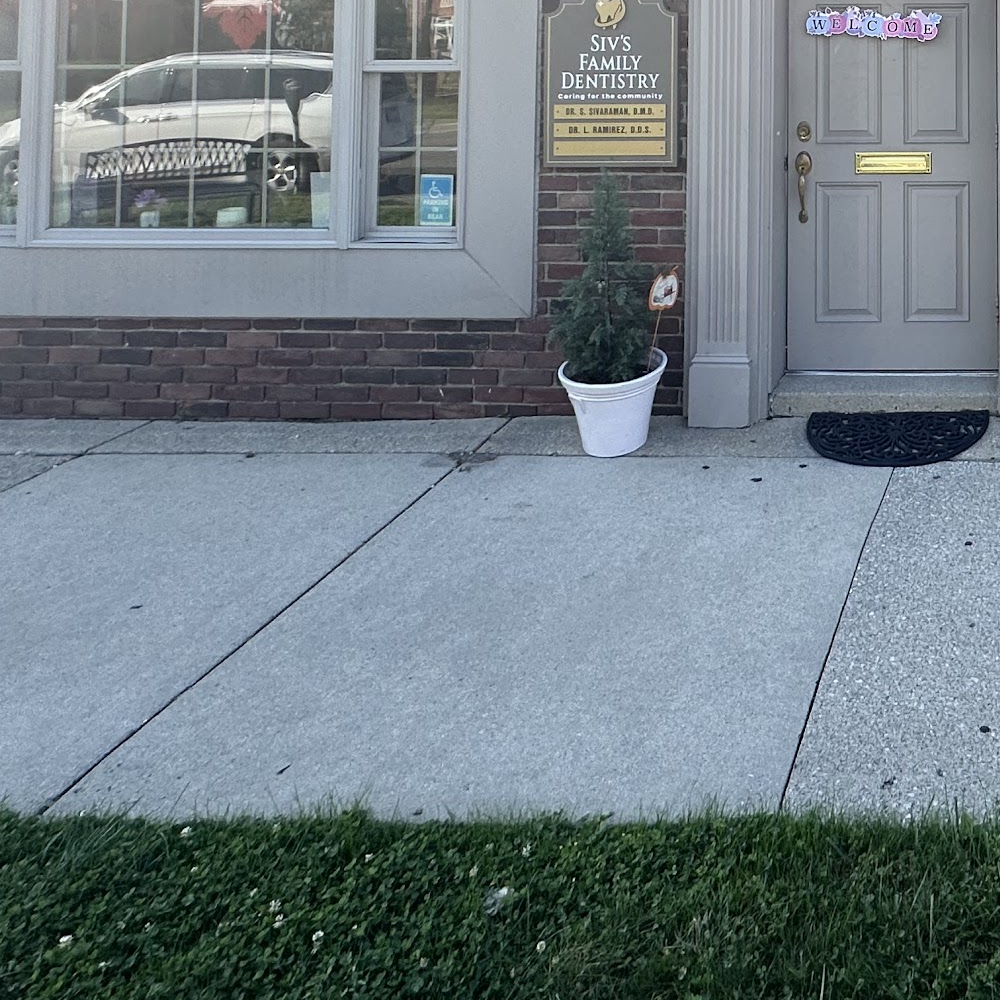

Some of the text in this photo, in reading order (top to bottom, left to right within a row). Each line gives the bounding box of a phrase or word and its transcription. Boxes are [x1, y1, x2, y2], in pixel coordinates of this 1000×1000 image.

[812, 18, 934, 35] WELCOME
[590, 34, 632, 52] SIV'S
[579, 53, 643, 71] FAMILY
[561, 72, 660, 89] DENTISTRY
[557, 93, 585, 101] Caring
[617, 93, 663, 101] community
[565, 107, 577, 116] DR.
[579, 107, 587, 116] S.
[583, 126, 590, 134] L.
